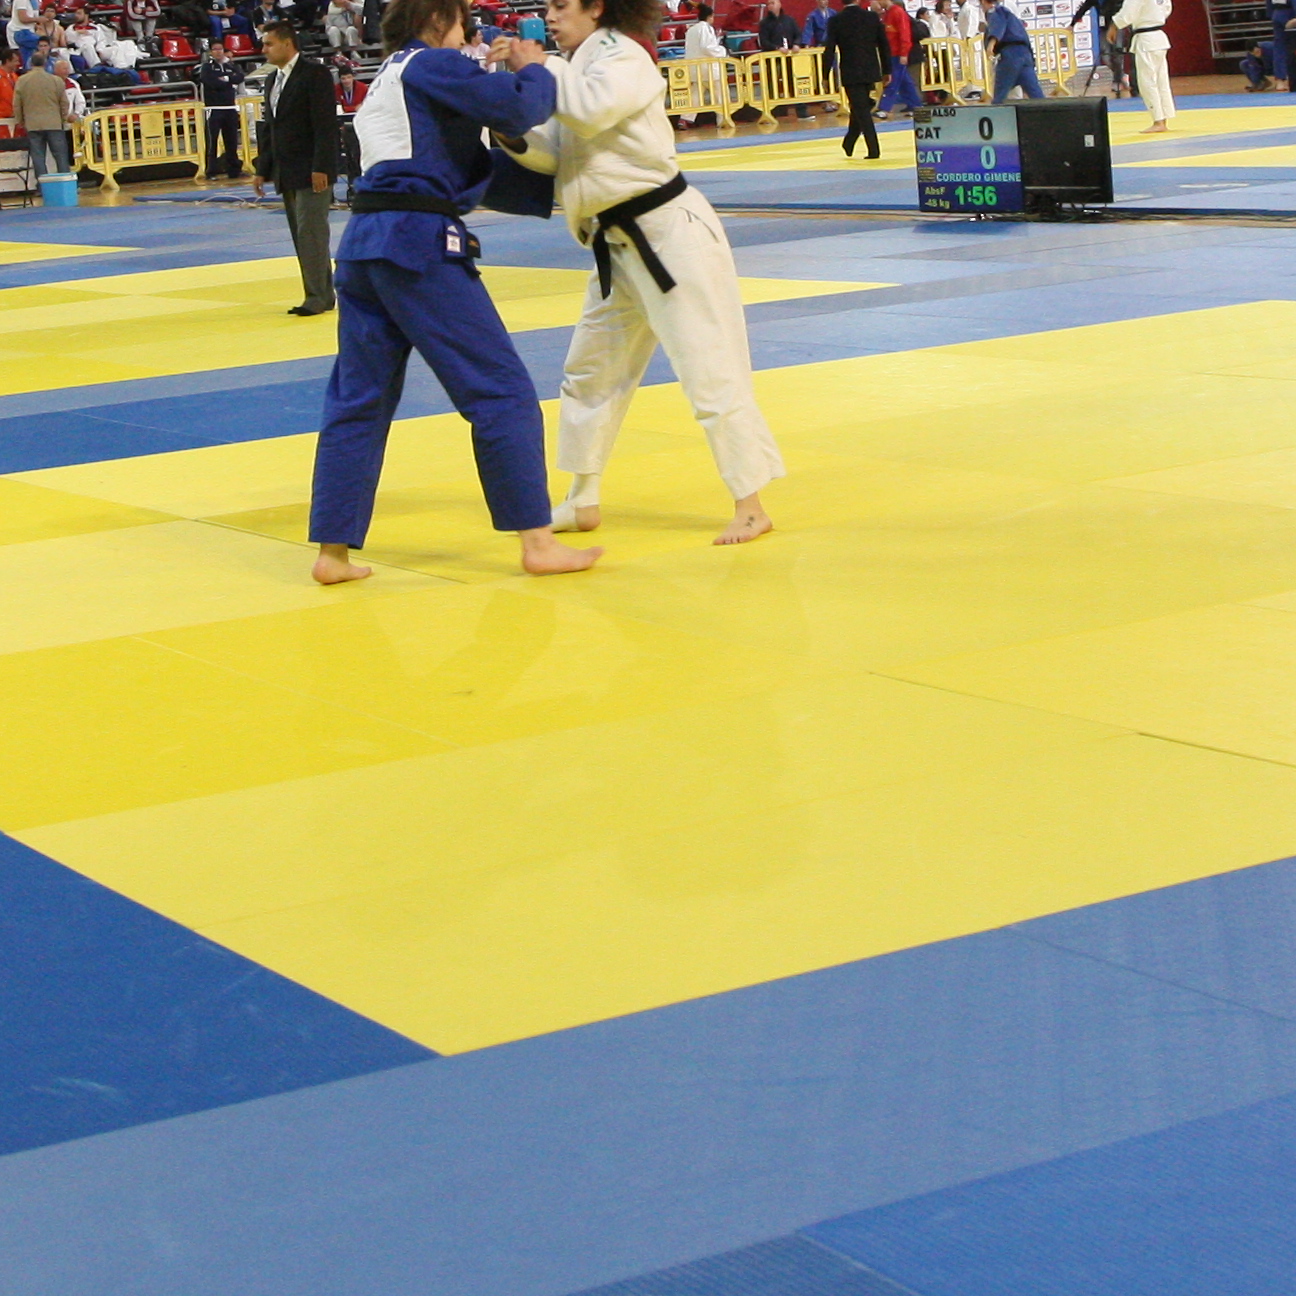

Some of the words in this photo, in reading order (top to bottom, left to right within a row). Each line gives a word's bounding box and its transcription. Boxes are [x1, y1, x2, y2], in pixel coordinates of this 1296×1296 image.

[915, 127, 942, 140] CAT
[978, 116, 994, 141] 0
[917, 150, 944, 164] CAT
[980, 145, 997, 170] 0
[936, 172, 982, 182] CORDERO
[984, 172, 1022, 182] GIMENE
[939, 198, 951, 210] kg
[954, 185, 998, 206] 1:56
